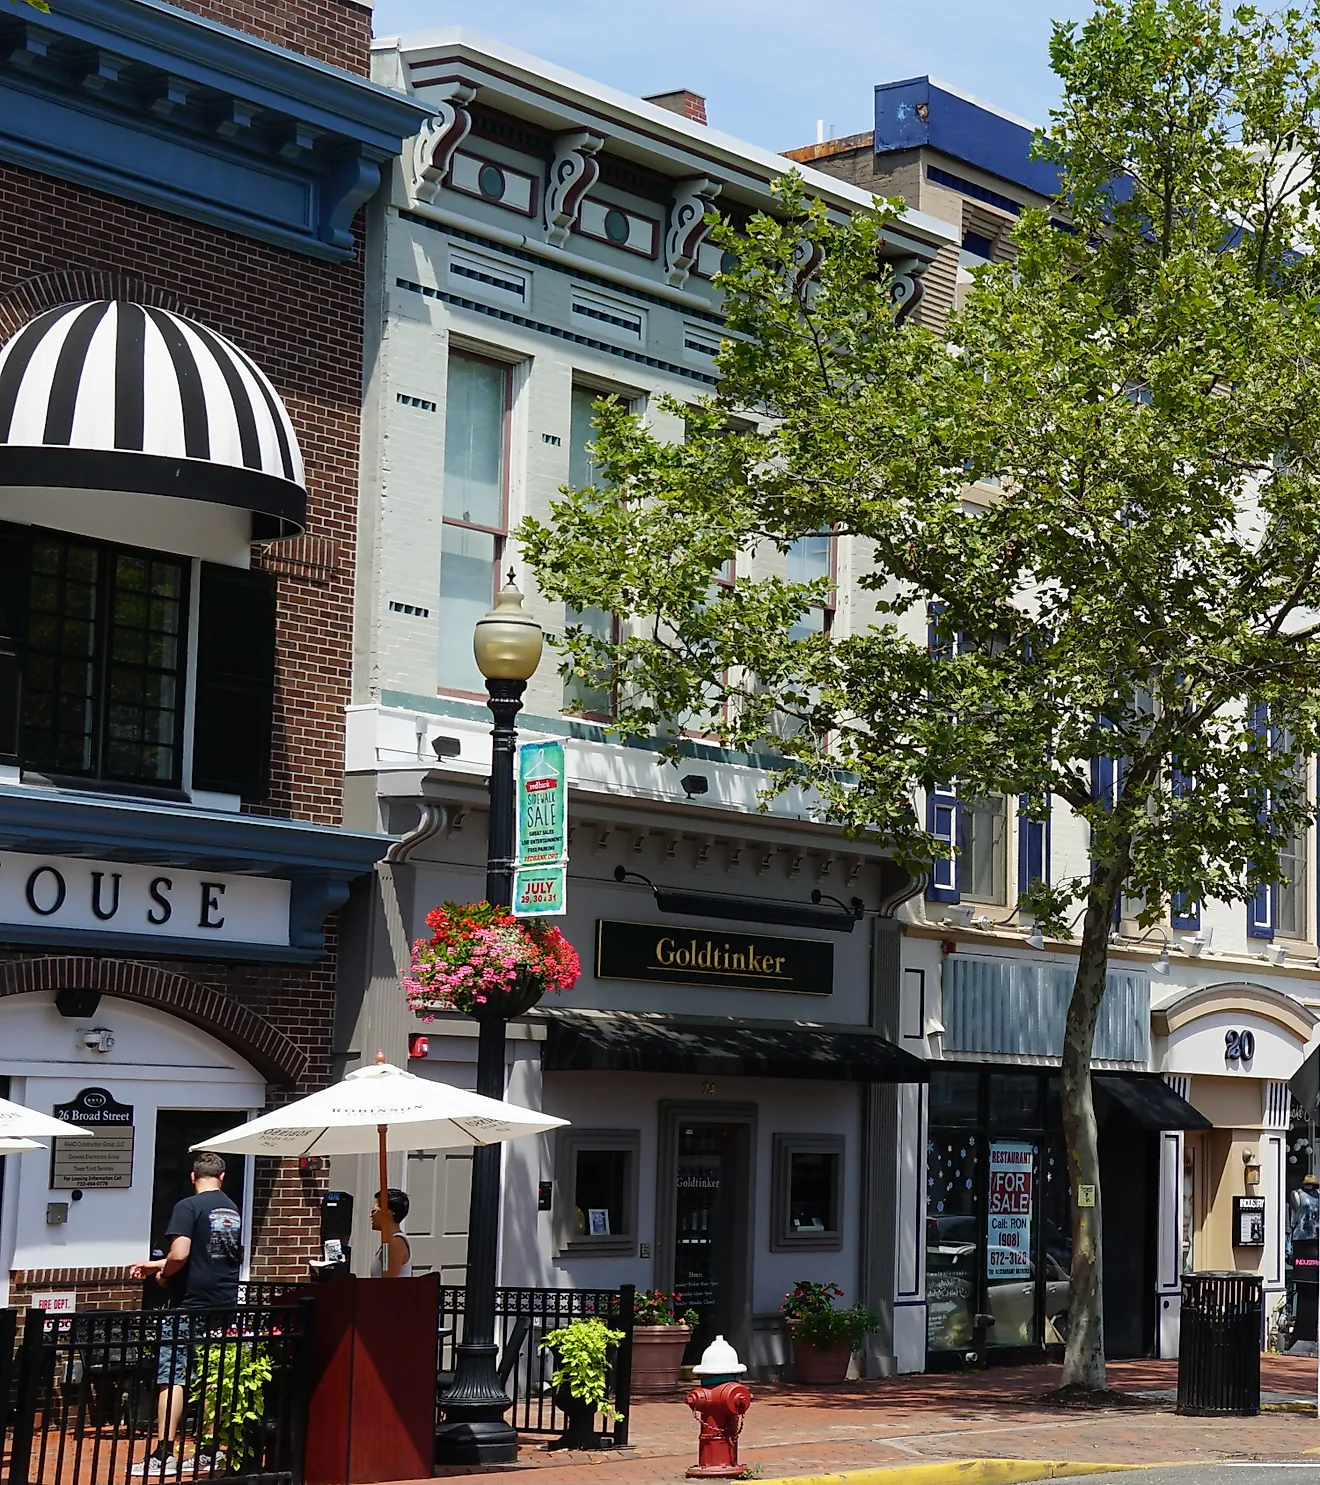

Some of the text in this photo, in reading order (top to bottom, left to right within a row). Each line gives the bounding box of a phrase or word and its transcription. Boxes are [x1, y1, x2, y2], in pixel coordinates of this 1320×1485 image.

[527, 792, 556, 805] SIDEWALK
[527, 804, 556, 828] SALE
[525, 882, 554, 894] JULY
[0, 863, 227, 929] OUSE
[521, 895, 532, 904] 29,
[533, 895, 543, 903] 30
[547, 894, 557, 902] 31
[655, 937, 787, 974] Goldtinker
[1225, 1029, 1256, 1061] 20
[58, 1110, 130, 1121] 26 Broad Street
[992, 1150, 1032, 1164] RESTAURANT
[676, 1177, 720, 1189] Goldtinker
[996, 1173, 1025, 1192] FOR
[992, 1193, 1029, 1213] SALE
[1240, 1198, 1265, 1208] INDUSTRY
[991, 1217, 1027, 1229] Call: RON
[998, 1232, 1020, 1247] (908)
[39, 1298, 71, 1310] FIRE DEPT.
